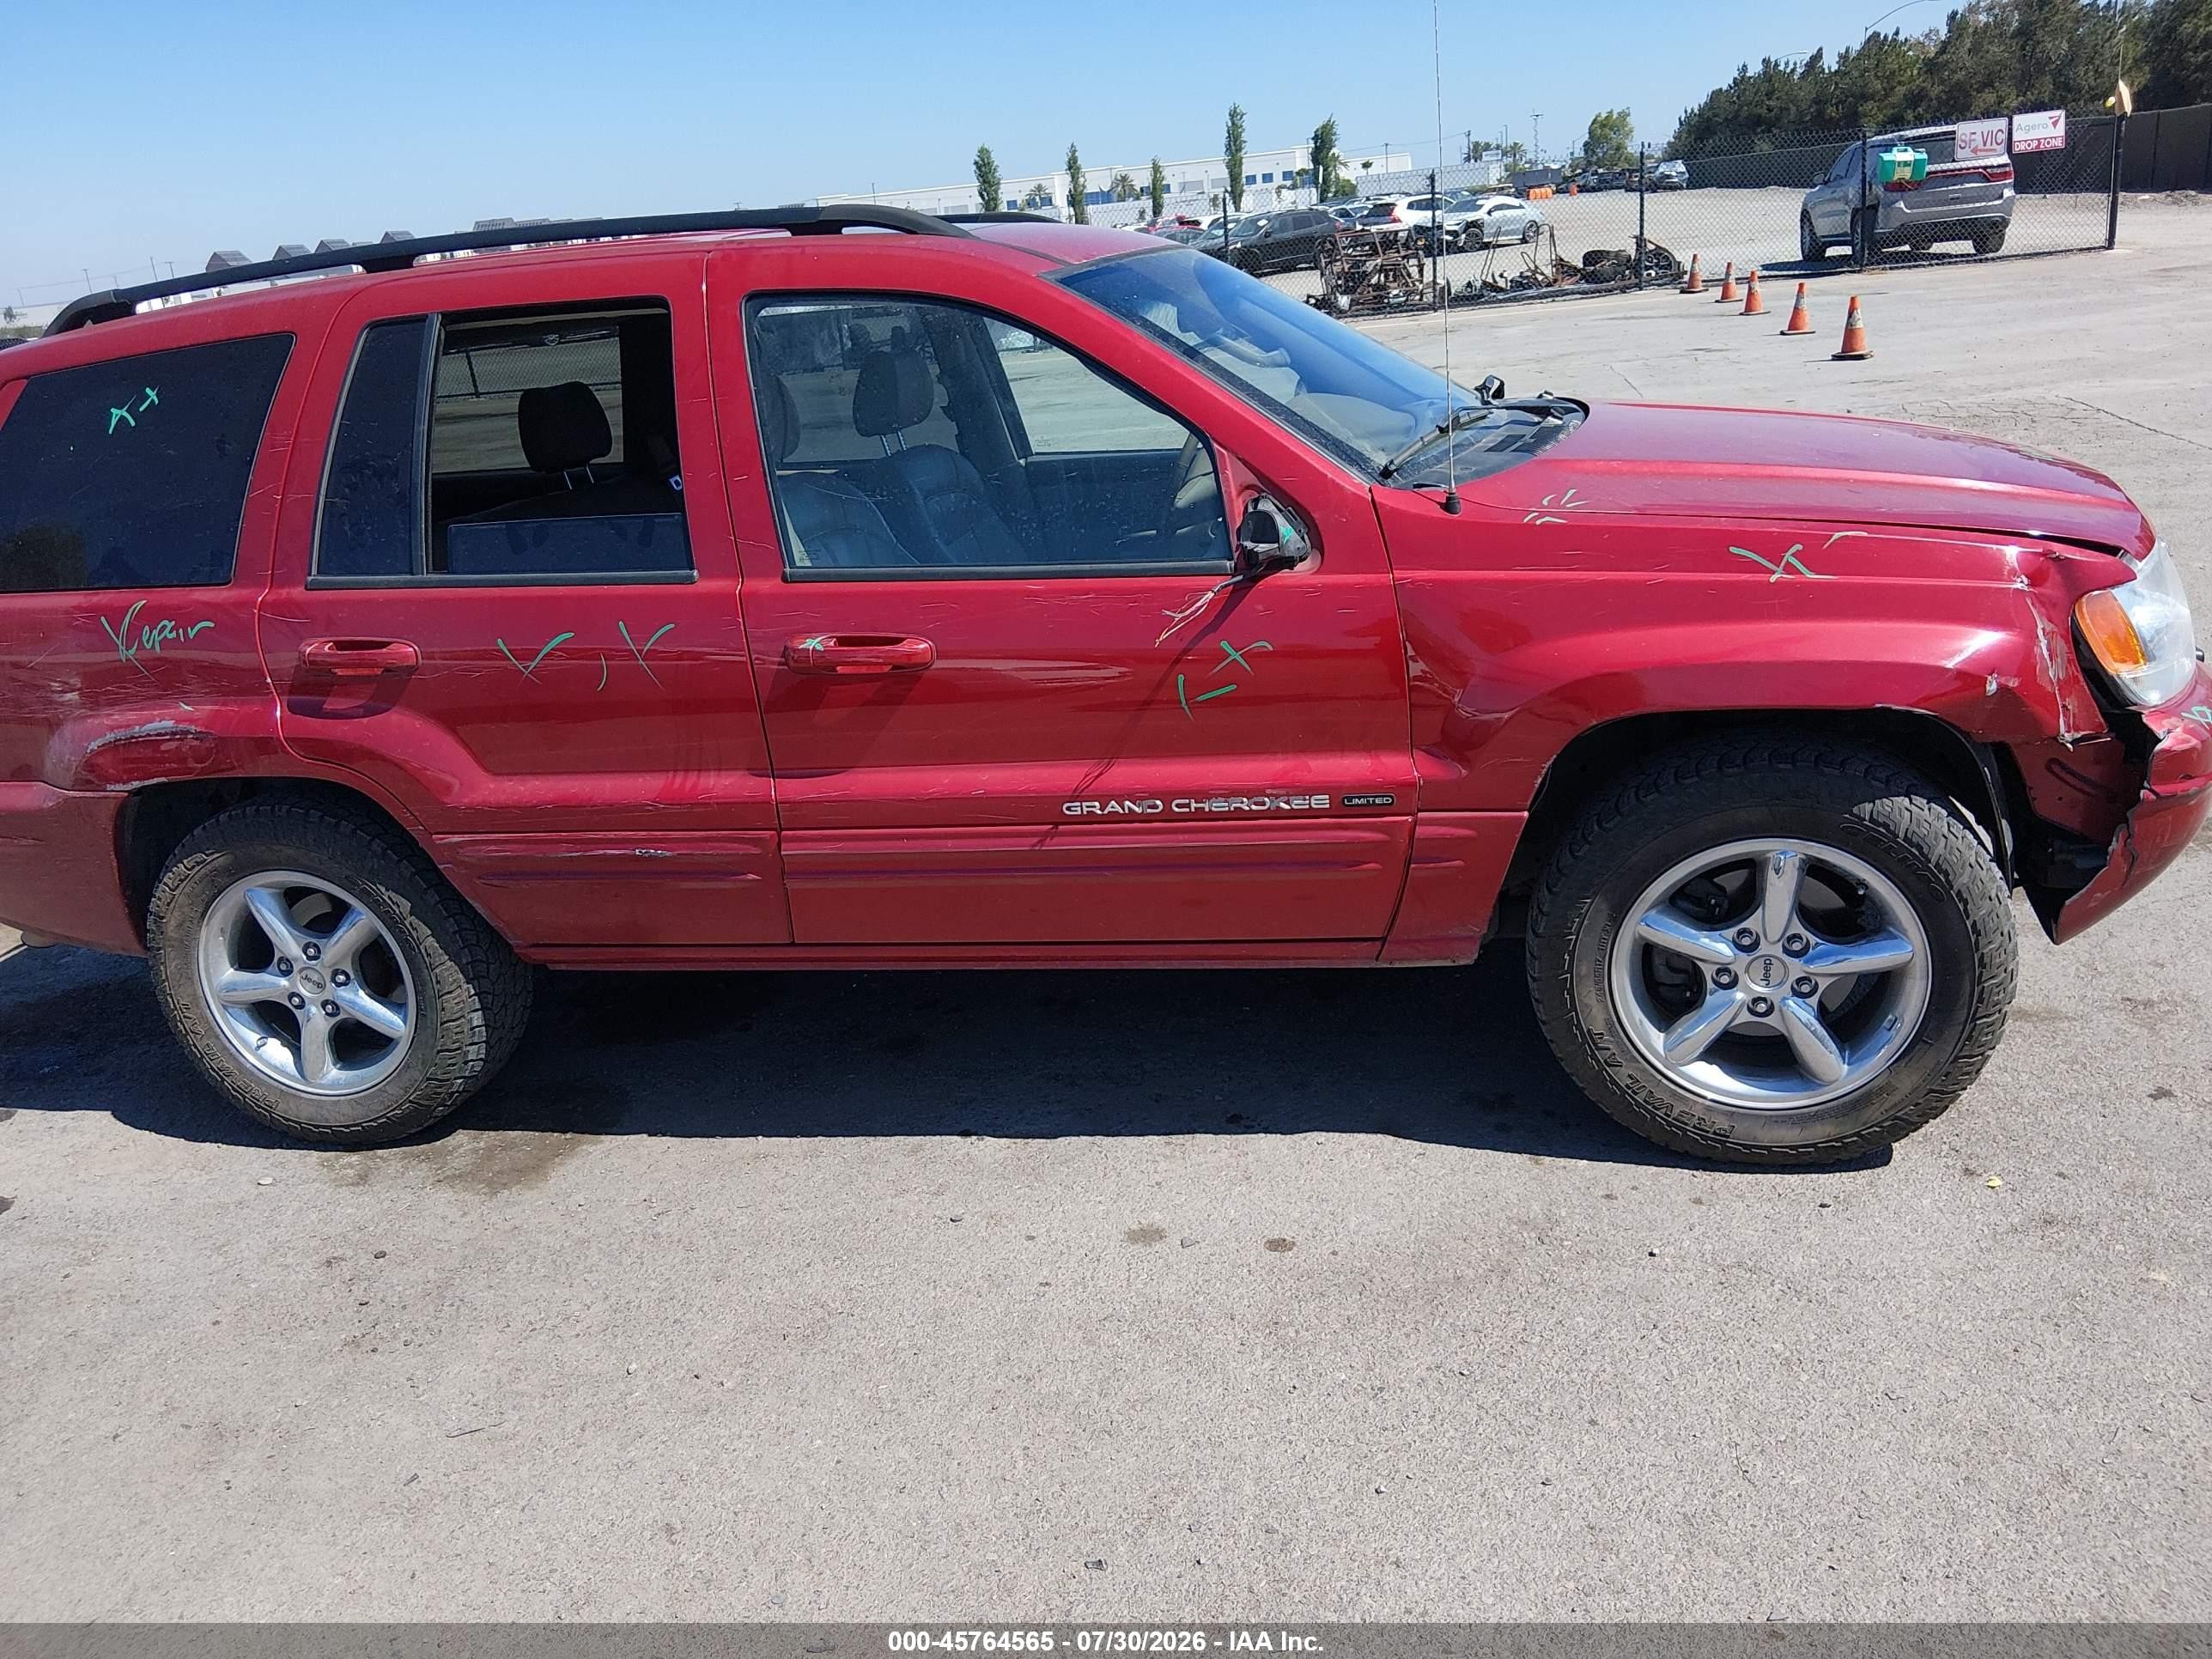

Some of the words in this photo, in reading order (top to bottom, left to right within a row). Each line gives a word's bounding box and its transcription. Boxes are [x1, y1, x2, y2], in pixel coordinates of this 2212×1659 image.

[1958, 131, 1977, 149] SF
[1981, 128, 2004, 147] VIC
[2014, 122, 2049, 134] Agero
[2014, 140, 2039, 152] DROP
[2039, 137, 2063, 149] ZONE
[1062, 799, 1164, 815] GRAND
[1170, 794, 1330, 812] CHEROKEE
[301, 974, 324, 989] Jeep
[1759, 958, 1775, 986] Jeep
[1586, 1026, 1626, 1069] A/T
[202, 1040, 282, 1112] PREVAIL
[1624, 1070, 1736, 1139] PREVAIL
